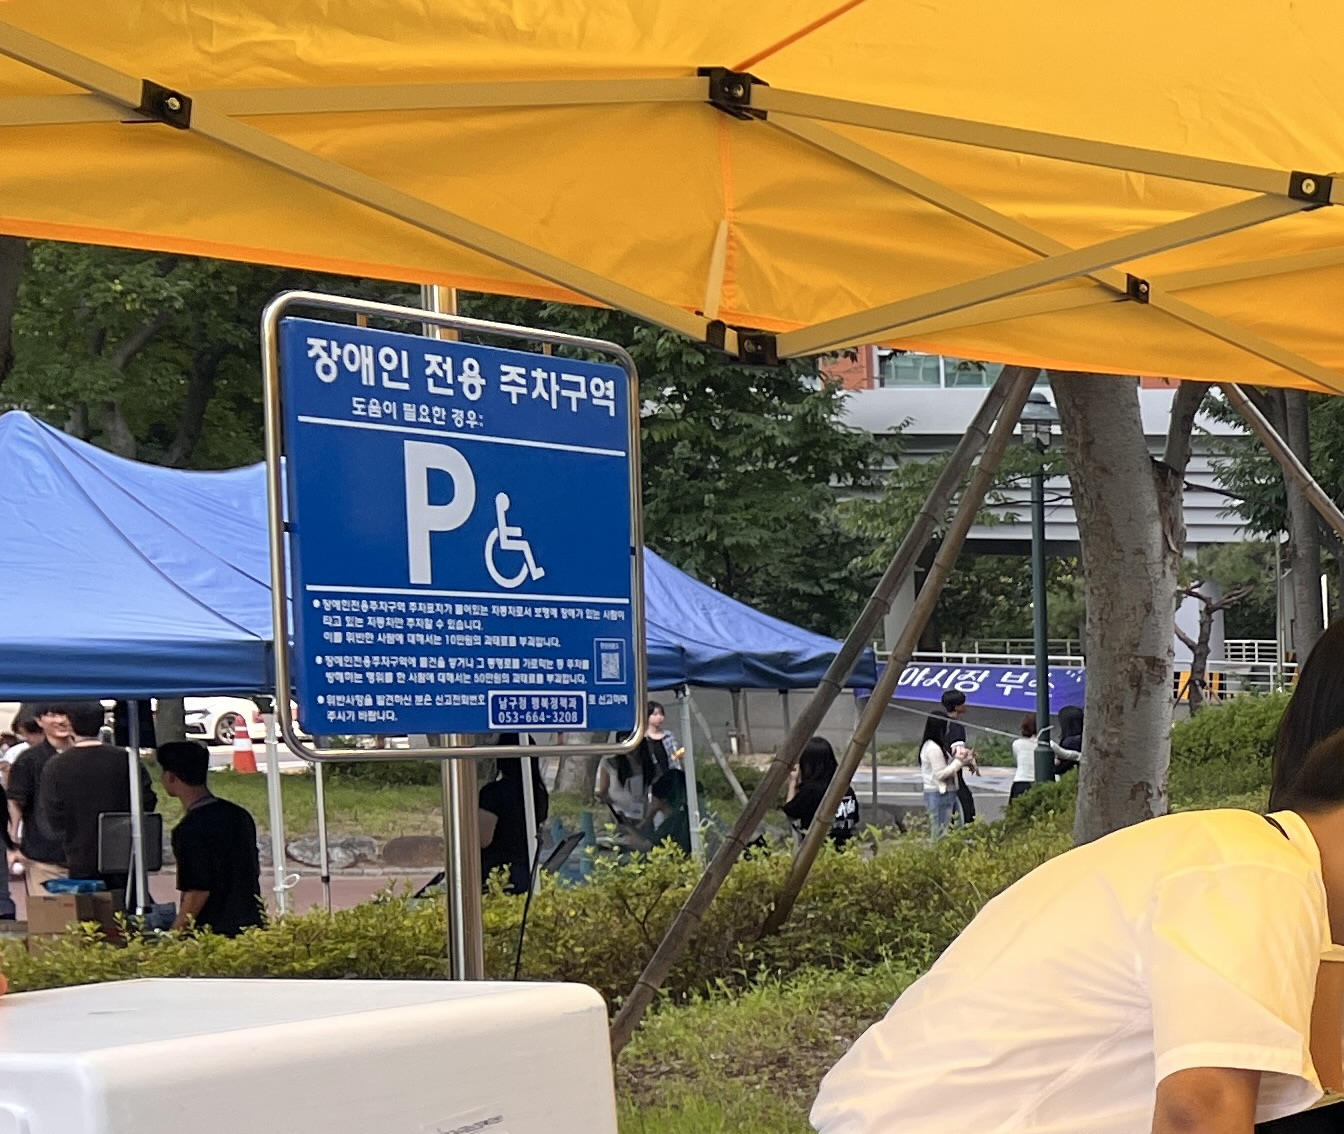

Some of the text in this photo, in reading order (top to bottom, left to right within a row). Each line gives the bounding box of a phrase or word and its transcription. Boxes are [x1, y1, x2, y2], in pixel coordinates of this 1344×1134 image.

[306, 337, 616, 417] 장애인 전용 주차구역
[352, 398, 484, 429] 도움이 필요한 경우:
[403, 439, 477, 585] P
[898, 667, 990, 692] 야시장
[327, 710, 398, 722] 주시기 바랍니다.
[498, 711, 578, 723] 053-664-3208
